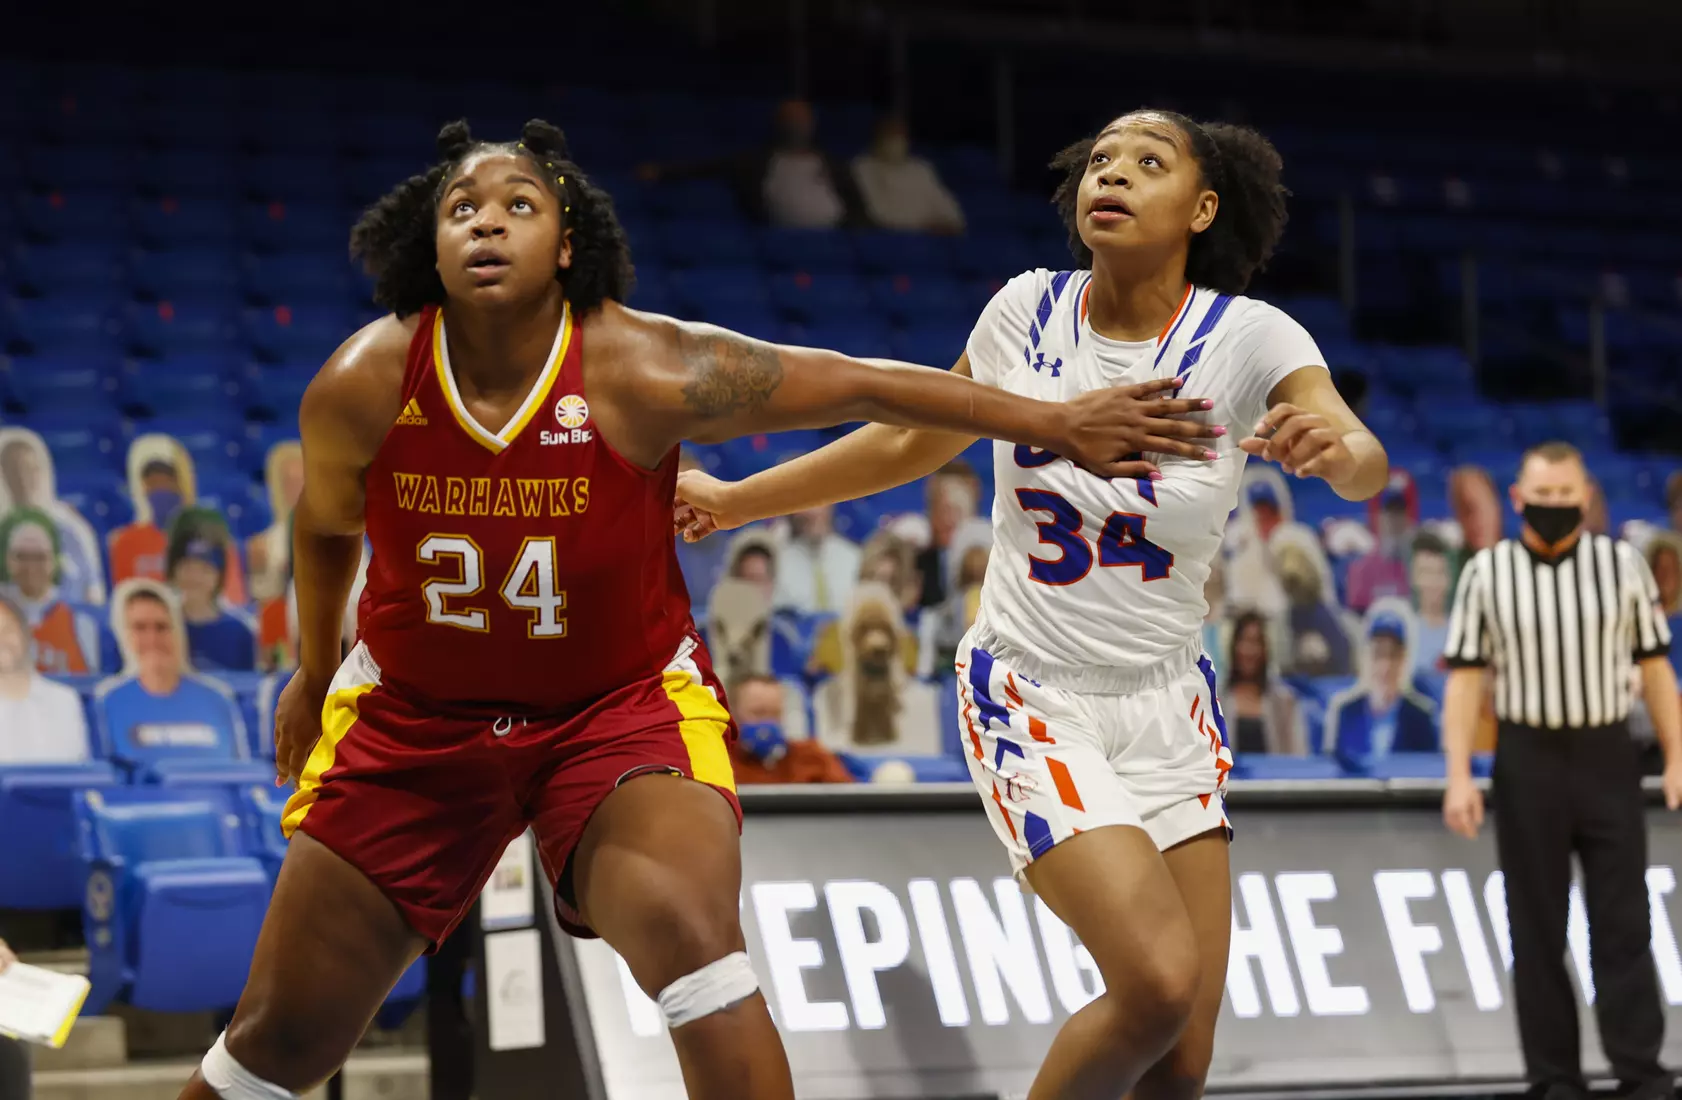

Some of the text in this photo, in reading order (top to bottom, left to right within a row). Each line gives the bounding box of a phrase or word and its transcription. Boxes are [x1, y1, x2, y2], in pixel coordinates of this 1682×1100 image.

[395, 415, 428, 426] adidas
[392, 472, 590, 517] WARHAWKS
[1014, 488, 1174, 586] 34
[416, 532, 567, 639] 24
[1225, 872, 1370, 1018] HE
